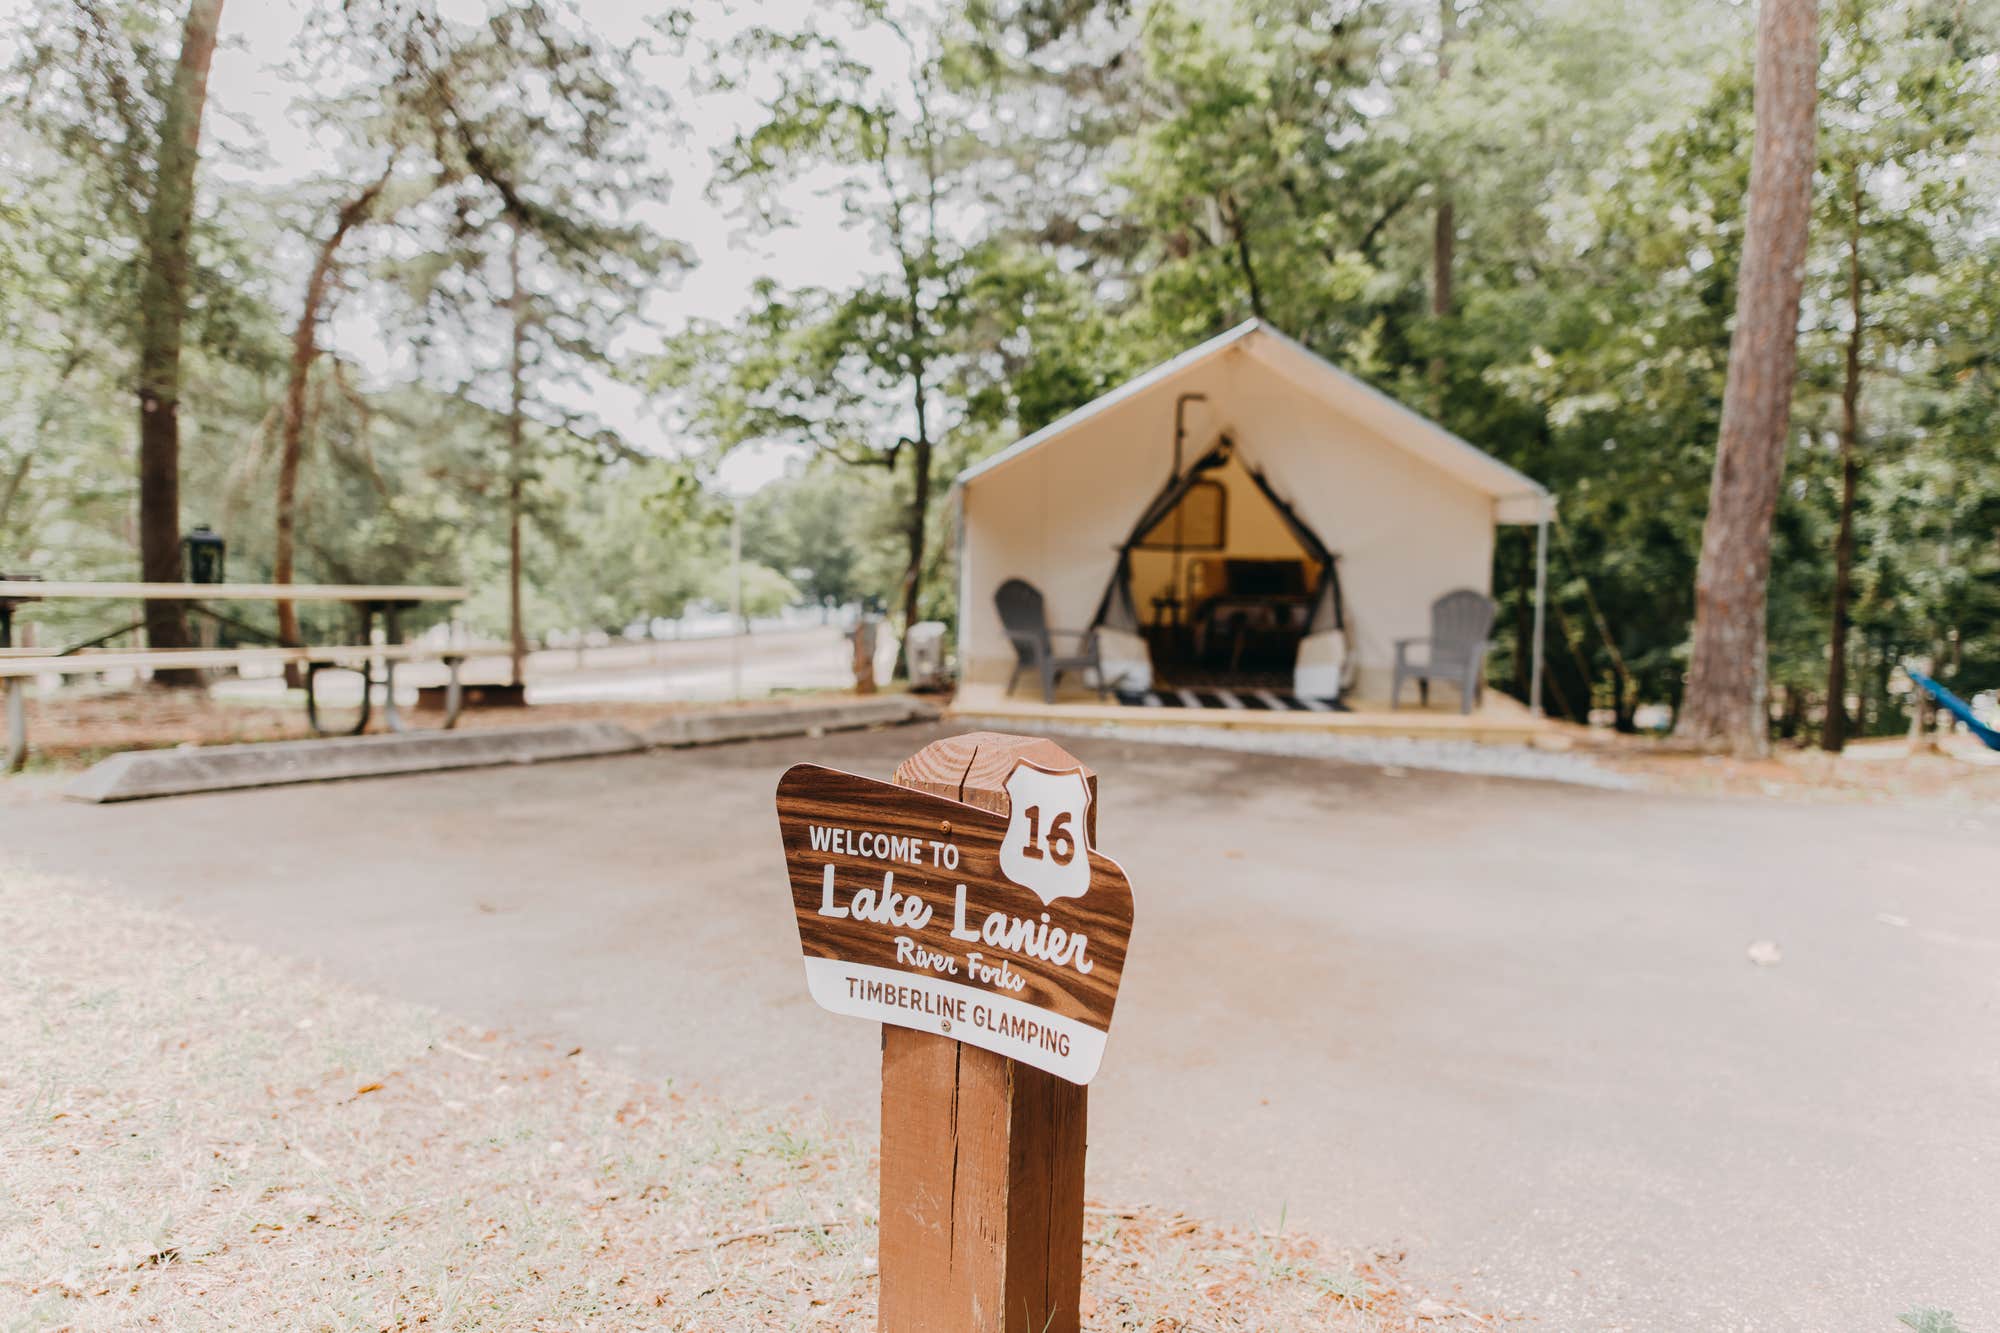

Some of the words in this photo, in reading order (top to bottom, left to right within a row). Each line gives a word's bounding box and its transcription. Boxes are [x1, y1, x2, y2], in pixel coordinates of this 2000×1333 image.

[809, 825, 923, 865] WELCOME
[929, 840, 959, 870] TO
[1022, 804, 1076, 867] 16
[818, 863, 933, 930] Lake
[950, 884, 1094, 974] Lanier
[894, 936, 958, 975] River
[966, 952, 1026, 993] Forks
[845, 976, 967, 1023] TIMBERLINE
[972, 1004, 1070, 1058] GLAMPING
